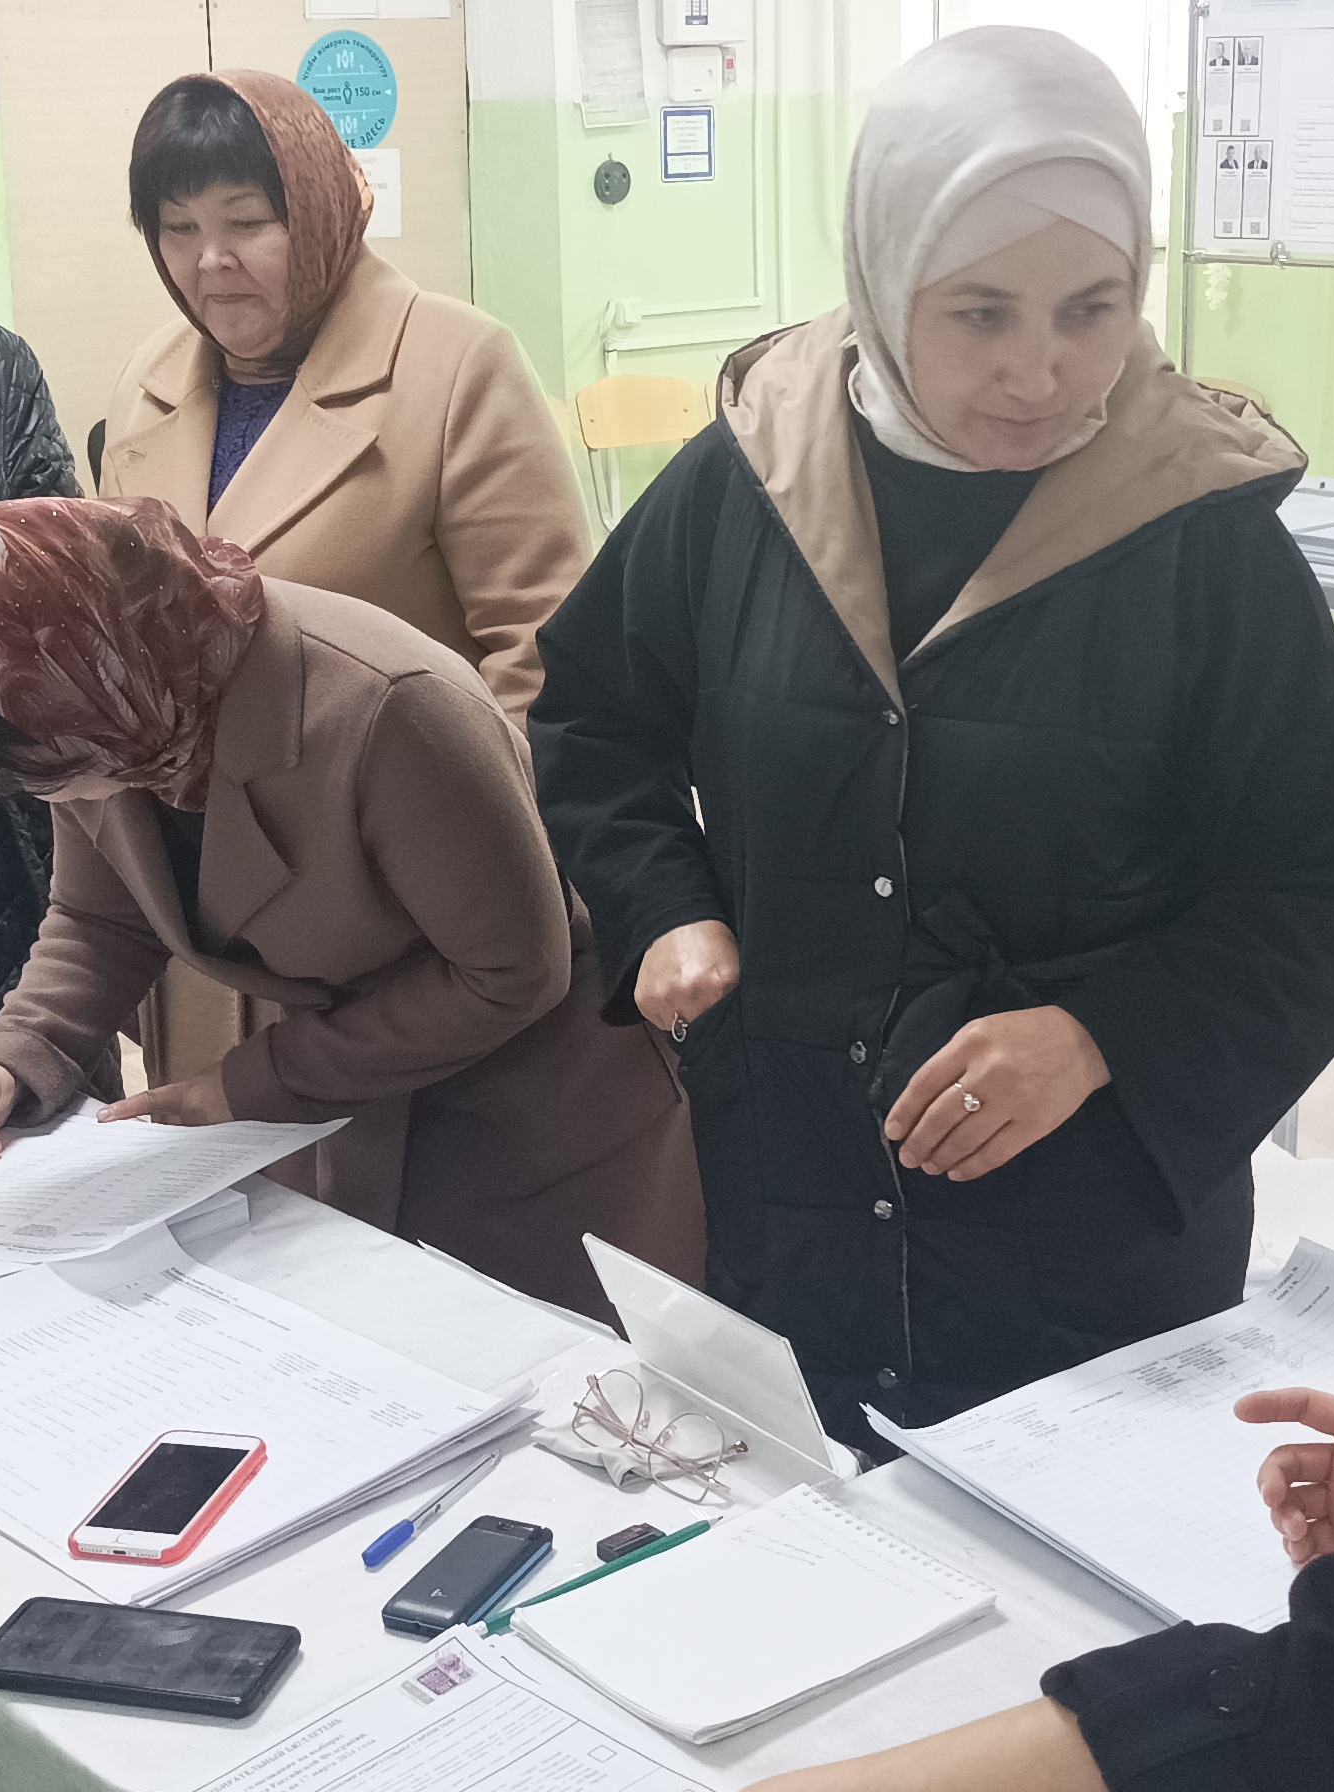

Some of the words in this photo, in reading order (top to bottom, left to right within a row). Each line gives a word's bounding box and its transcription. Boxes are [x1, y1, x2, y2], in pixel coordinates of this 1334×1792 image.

[301, 55, 318, 81] Чтобы
[352, 39, 388, 78] температуру
[354, 86, 370, 97] 150
[359, 117, 386, 146] ЗДЕСЬ
[285, 1718, 343, 1753] БЮЛЛЕТЕНЬ
